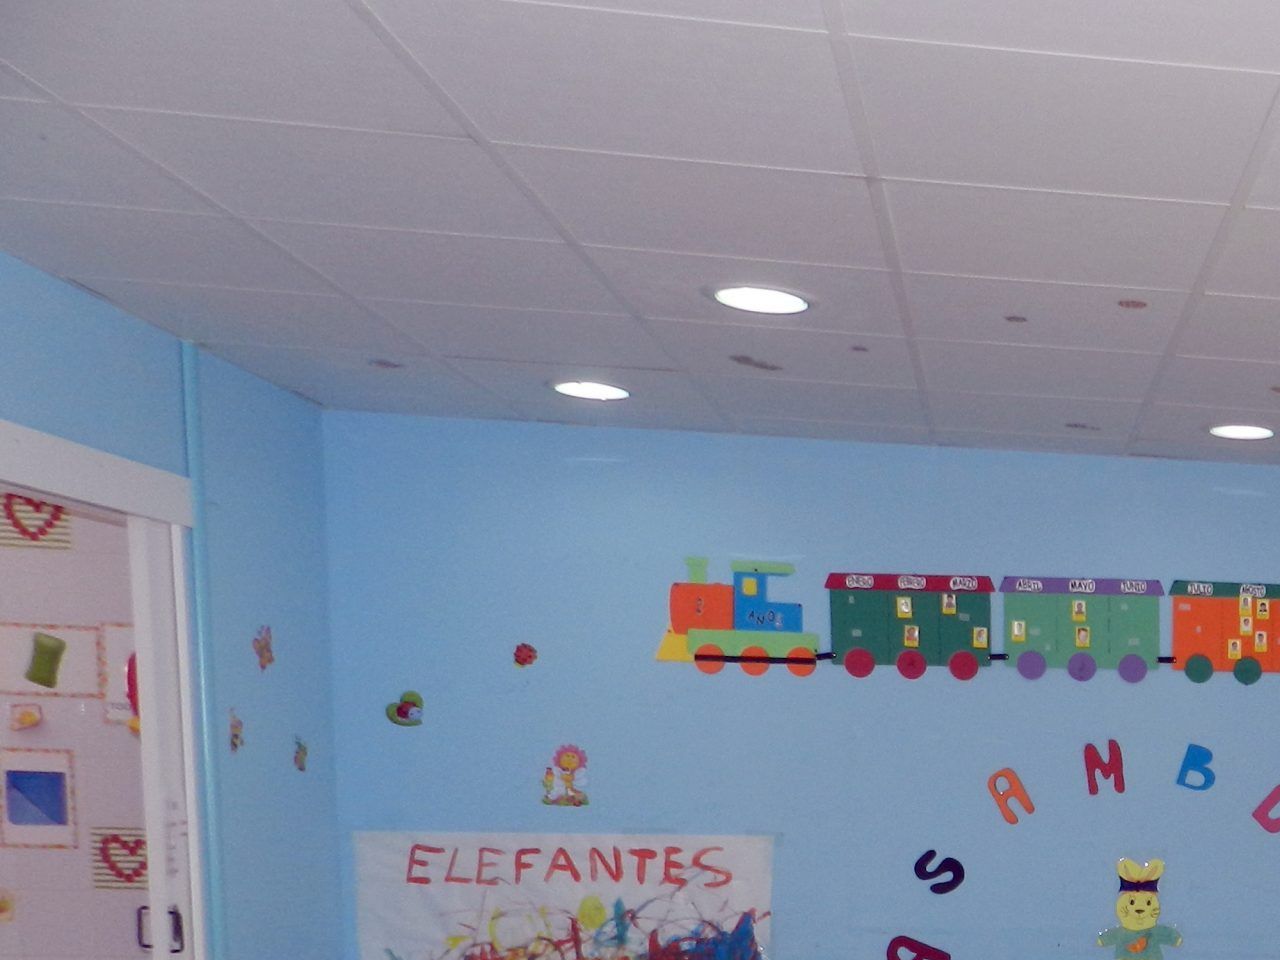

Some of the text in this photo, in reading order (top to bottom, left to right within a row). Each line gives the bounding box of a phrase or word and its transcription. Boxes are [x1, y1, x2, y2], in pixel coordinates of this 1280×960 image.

[1017, 579, 1145, 592] ABRIL MAYO JUNIO
[1188, 583, 1211, 594] JULIO
[406, 843, 733, 887] ELEFANTES
